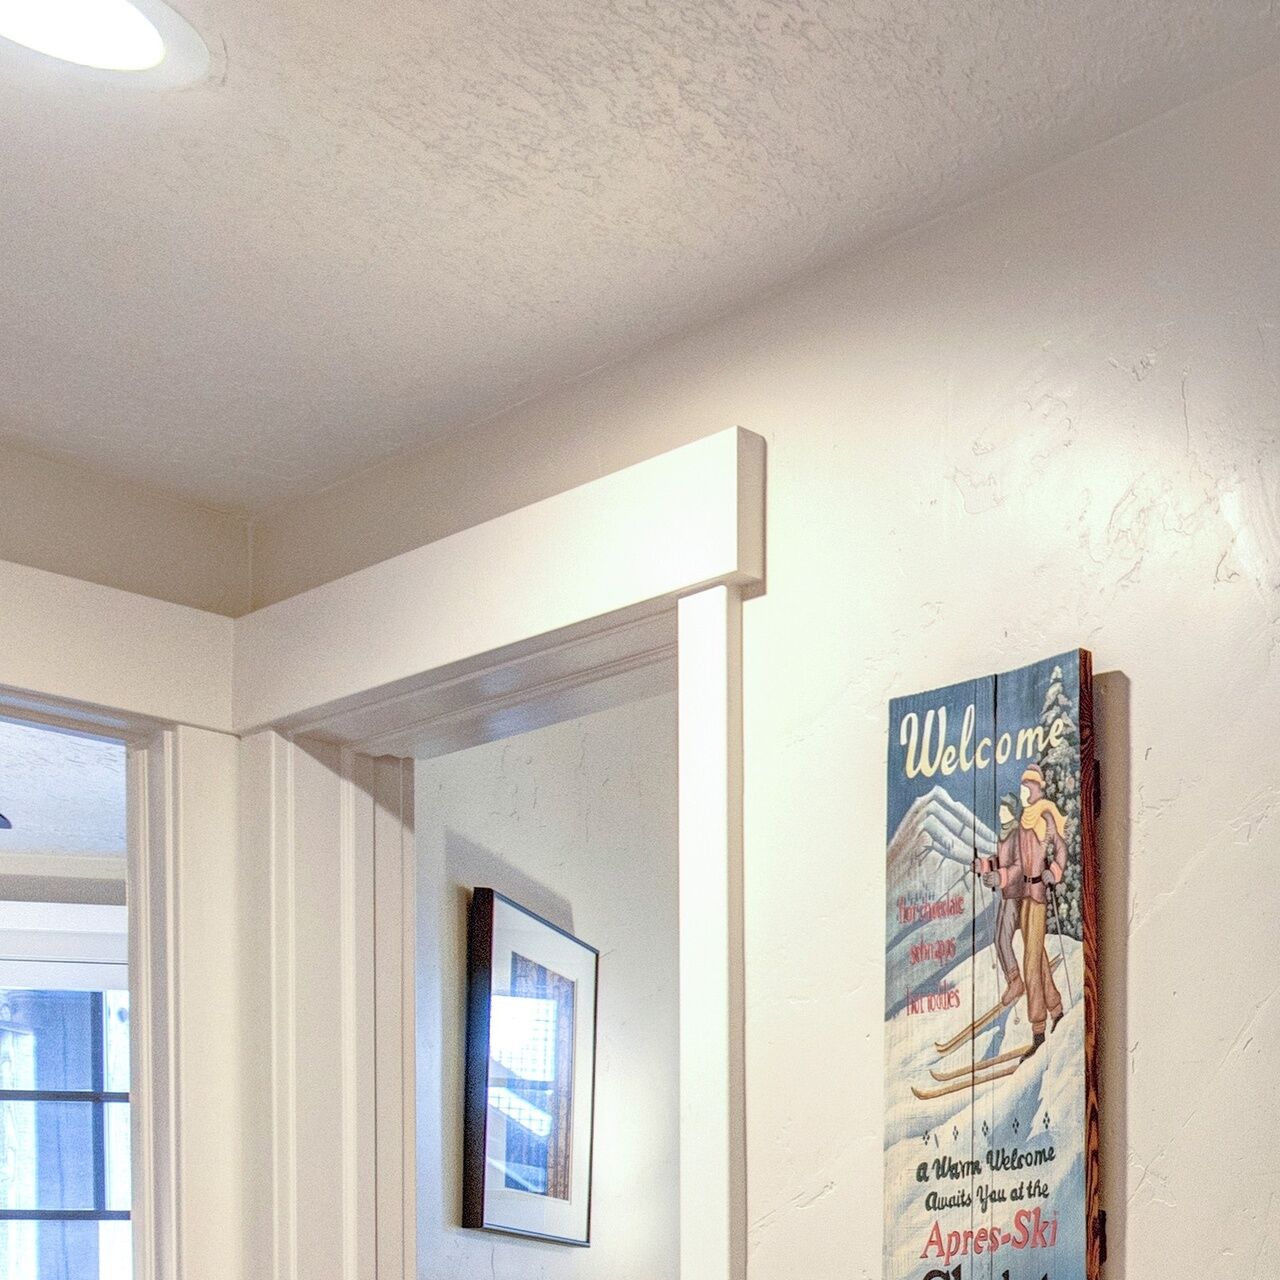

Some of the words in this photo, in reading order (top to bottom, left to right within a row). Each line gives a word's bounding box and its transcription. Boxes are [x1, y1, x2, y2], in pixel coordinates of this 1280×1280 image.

[899, 703, 1066, 780] Welcome
[931, 1155, 982, 1180] Warm
[986, 1146, 1056, 1171] Welcome
[925, 1190, 972, 1212] Awaits
[976, 1183, 1007, 1213] You
[1010, 1181, 1024, 1202] at
[1026, 1178, 1050, 1199] the
